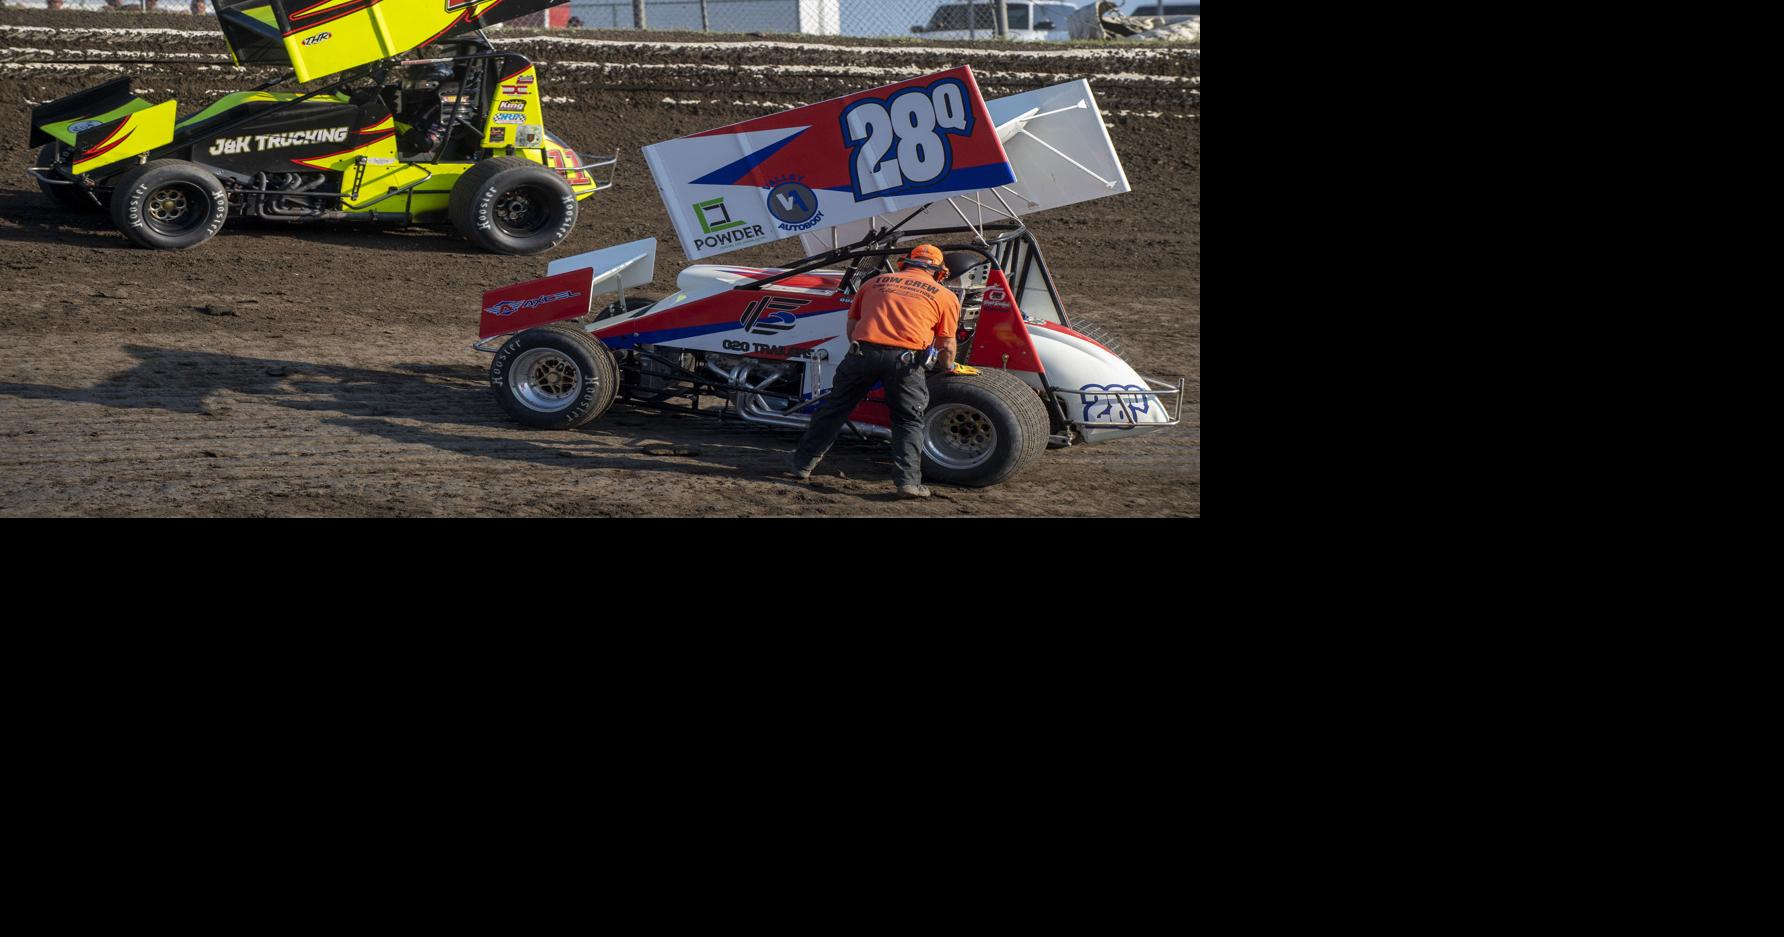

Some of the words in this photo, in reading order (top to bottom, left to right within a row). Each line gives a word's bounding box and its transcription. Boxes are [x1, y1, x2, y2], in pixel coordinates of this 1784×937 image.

[500, 101, 525, 110] King
[209, 136, 251, 156] J&K
[255, 127, 349, 151] TRUCKING
[841, 79, 971, 198] 28Q
[778, 210, 824, 232] AUTOBODY
[694, 224, 765, 251] POWDER
[876, 276, 902, 284] TOW
[904, 280, 939, 295] CREW
